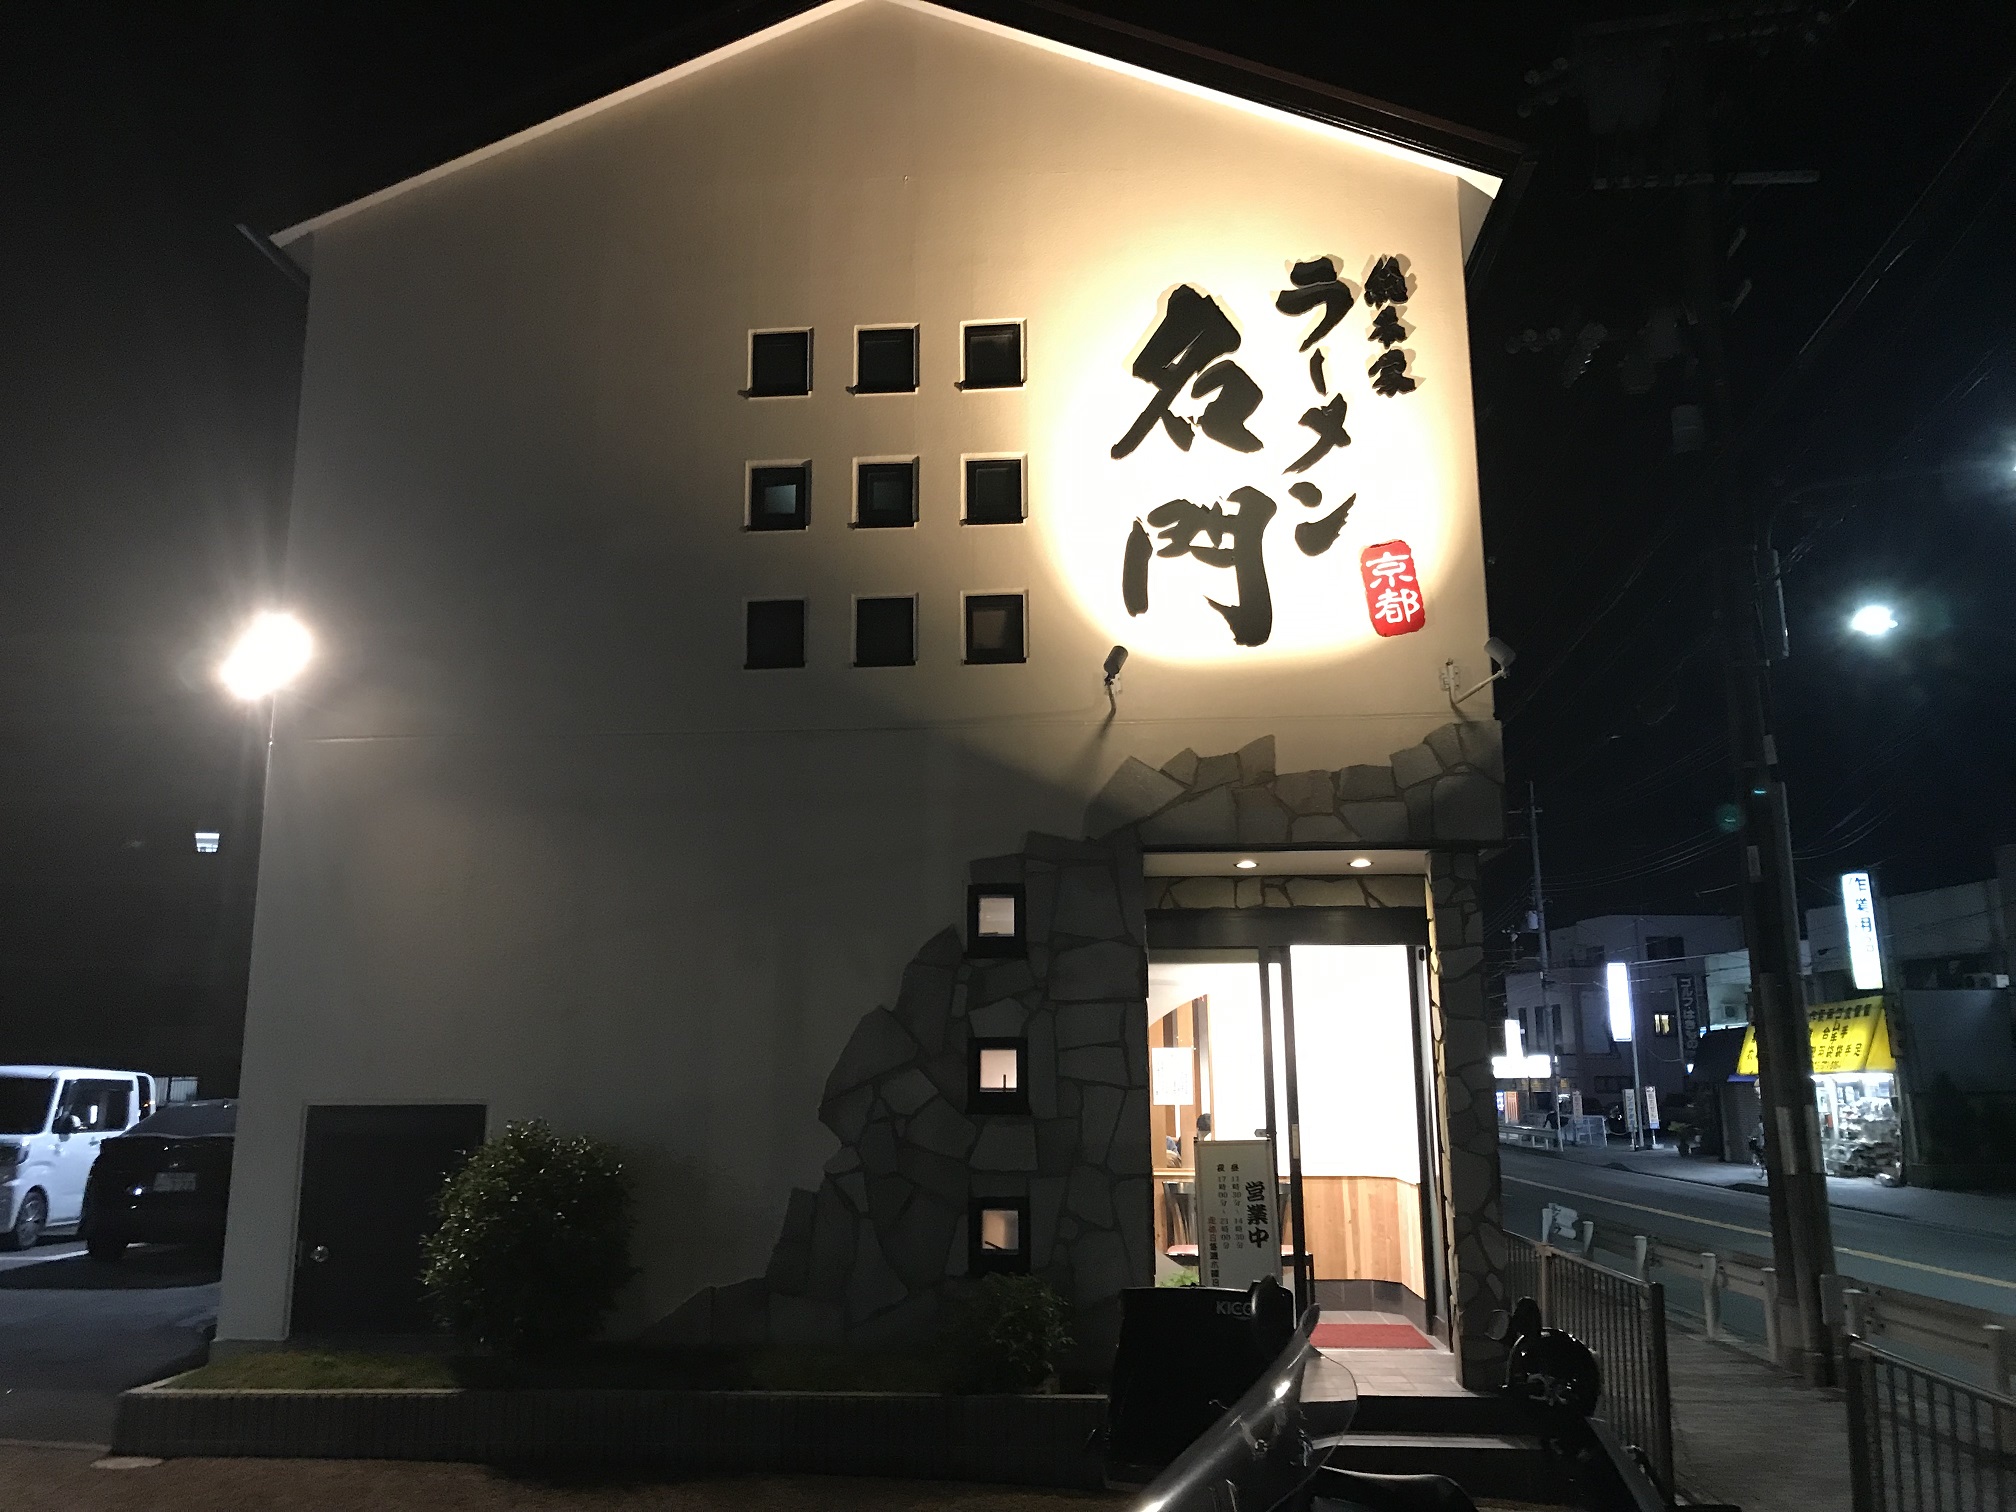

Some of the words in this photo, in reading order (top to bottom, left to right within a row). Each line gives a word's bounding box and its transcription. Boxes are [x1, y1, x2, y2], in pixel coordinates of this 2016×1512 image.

[1110, 284, 1278, 647] 名門
[1276, 256, 1357, 556] ラーメン
[1366, 552, 1421, 624] 京都
[1245, 1180, 1269, 1249] 営業中
